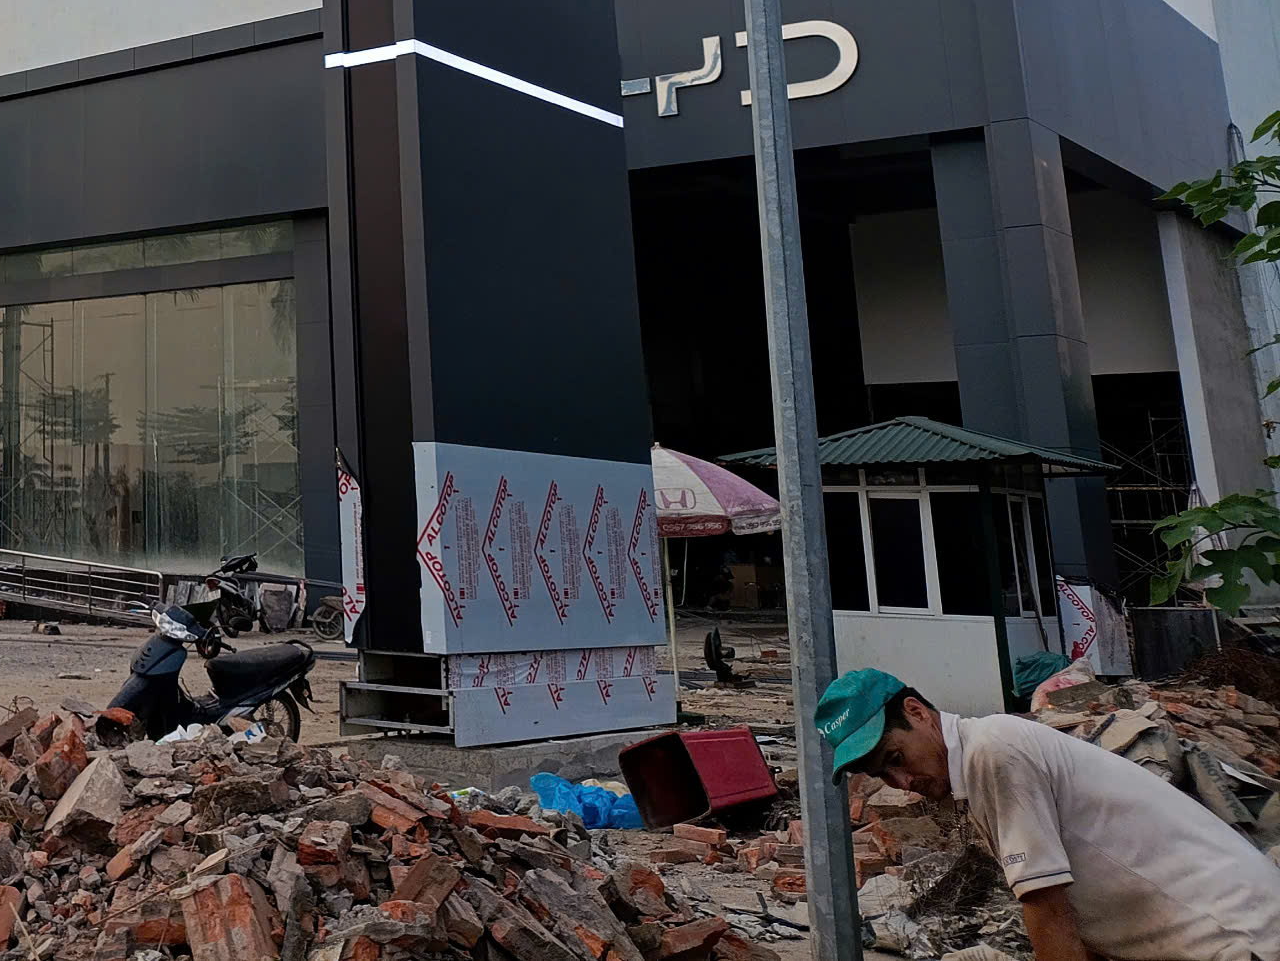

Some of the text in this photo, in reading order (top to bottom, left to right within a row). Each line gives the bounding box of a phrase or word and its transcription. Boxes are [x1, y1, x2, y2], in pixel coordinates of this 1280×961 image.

[426, 474, 454, 547] ALCOTOP
[488, 478, 508, 548] ALCOTOP
[539, 483, 558, 550] ALCOTOP
[587, 487, 604, 552] ALCOTOP
[632, 490, 647, 553] ALCOTOP
[425, 551, 463, 620] ALCOTOP
[487, 553, 518, 619] ALCOTOP
[539, 555, 568, 618] ALCOTOP
[587, 556, 615, 617] ALCOTOP
[632, 557, 658, 616] ALCOTOP
[1057, 583, 1096, 623] ALCOTOP
[824, 708, 850, 734] Casper
